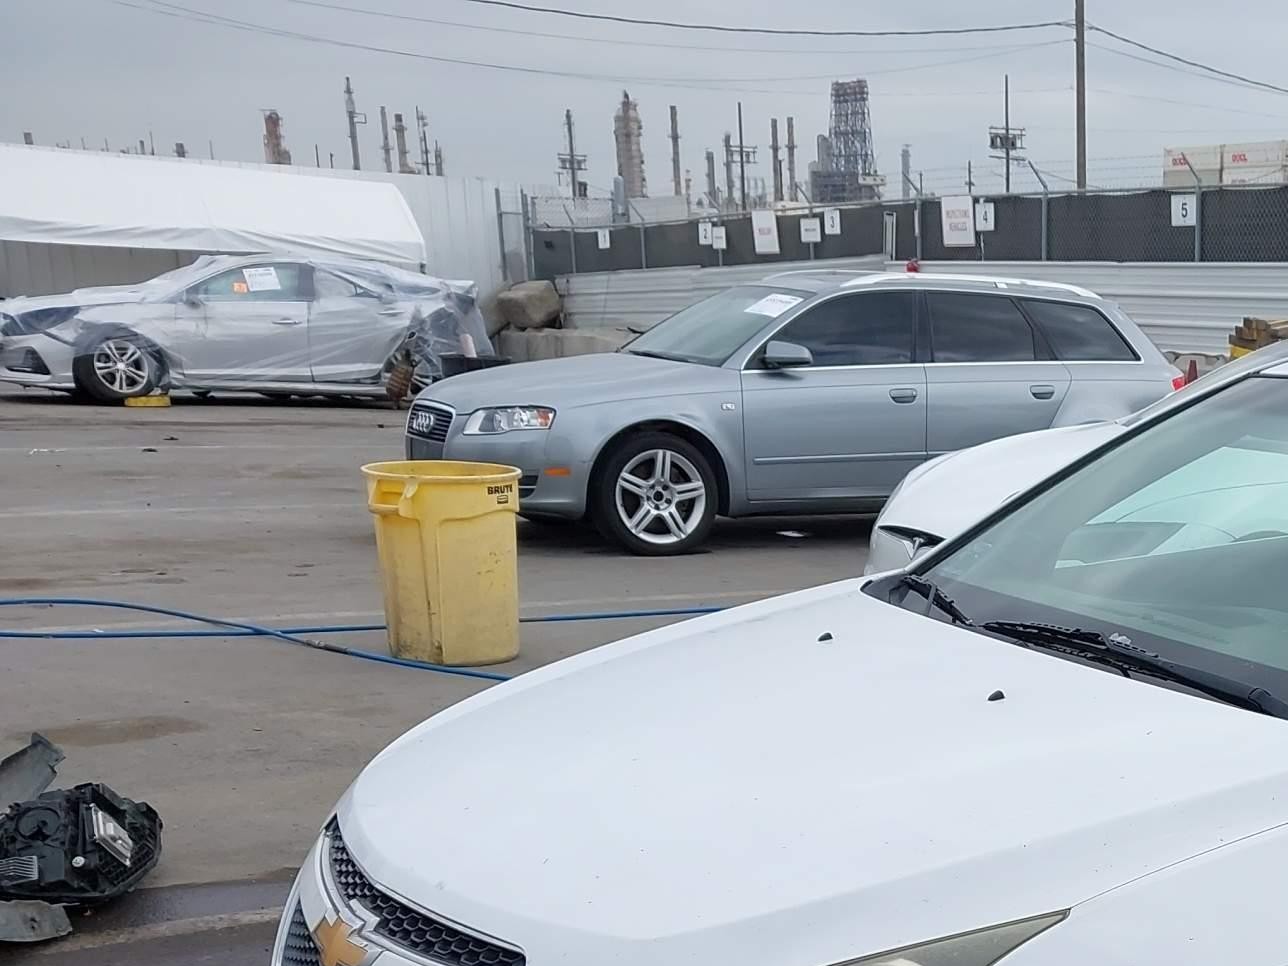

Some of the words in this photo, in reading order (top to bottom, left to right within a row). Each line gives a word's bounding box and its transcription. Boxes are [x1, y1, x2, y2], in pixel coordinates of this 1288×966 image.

[1181, 202, 1188, 217] 5
[830, 215, 836, 229] 3
[982, 210, 988, 224] 4
[703, 228, 708, 240] 2
